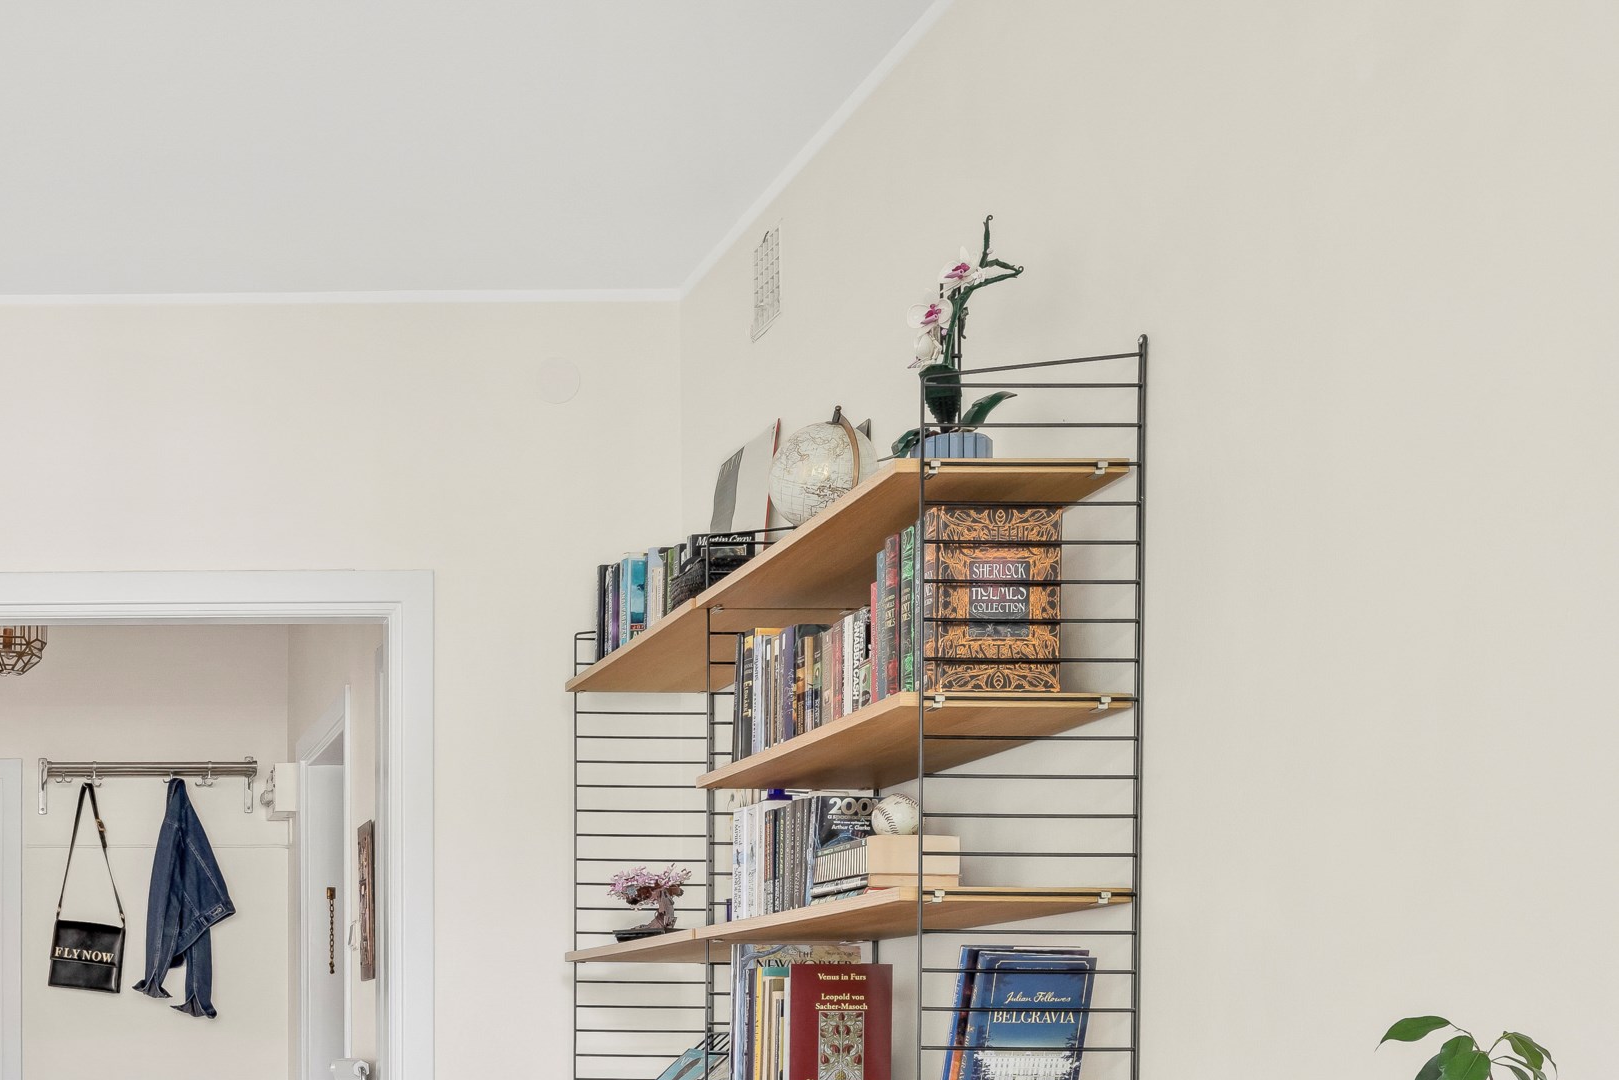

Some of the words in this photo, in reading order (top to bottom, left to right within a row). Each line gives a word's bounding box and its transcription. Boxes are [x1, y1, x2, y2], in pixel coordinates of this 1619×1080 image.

[972, 563, 1027, 579] SHERLOCK
[972, 582, 1027, 600] HOLMES
[972, 602, 1027, 613] COLLECTION
[853, 620, 861, 669] SNABBA
[852, 668, 860, 700] CASH
[54, 946, 81, 960] FLY
[82, 949, 115, 963] NOW
[817, 972, 840, 981] Venus
[850, 972, 867, 980] Furs
[821, 993, 850, 1002] Leopold
[1004, 991, 1032, 1004] Julian
[1033, 991, 1071, 1003] Fellowes
[815, 1002, 868, 1010] Sacher-Masoch
[992, 1010, 1076, 1024] BELGRAVIA
